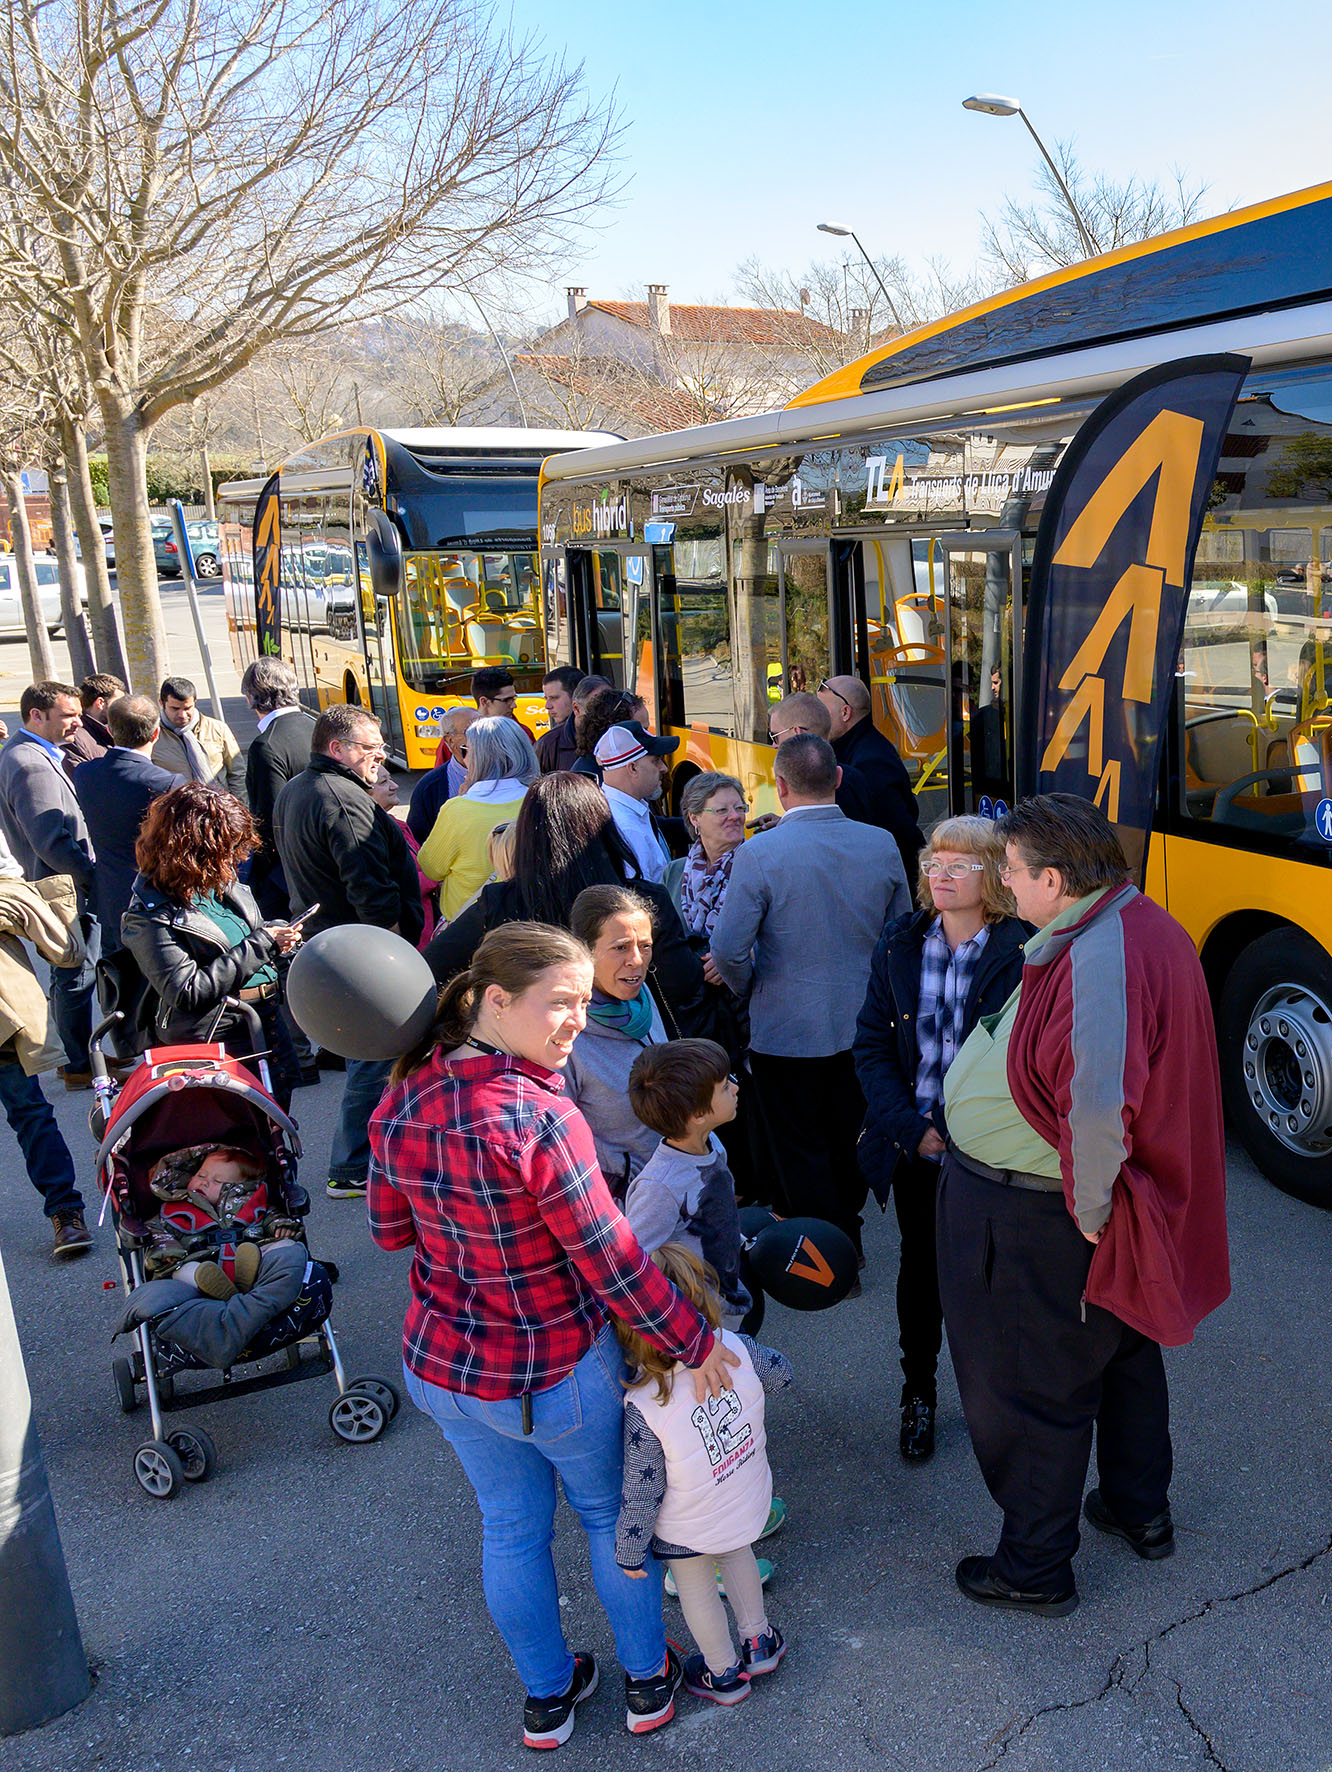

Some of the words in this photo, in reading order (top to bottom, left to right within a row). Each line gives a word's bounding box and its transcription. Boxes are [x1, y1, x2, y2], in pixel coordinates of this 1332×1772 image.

[702, 486, 750, 509] Sagalés
[911, 475, 963, 499] Transports
[964, 472, 979, 495] de
[981, 470, 1009, 501] Lliçà
[573, 502, 592, 534] bus
[691, 1385, 752, 1466] 12
